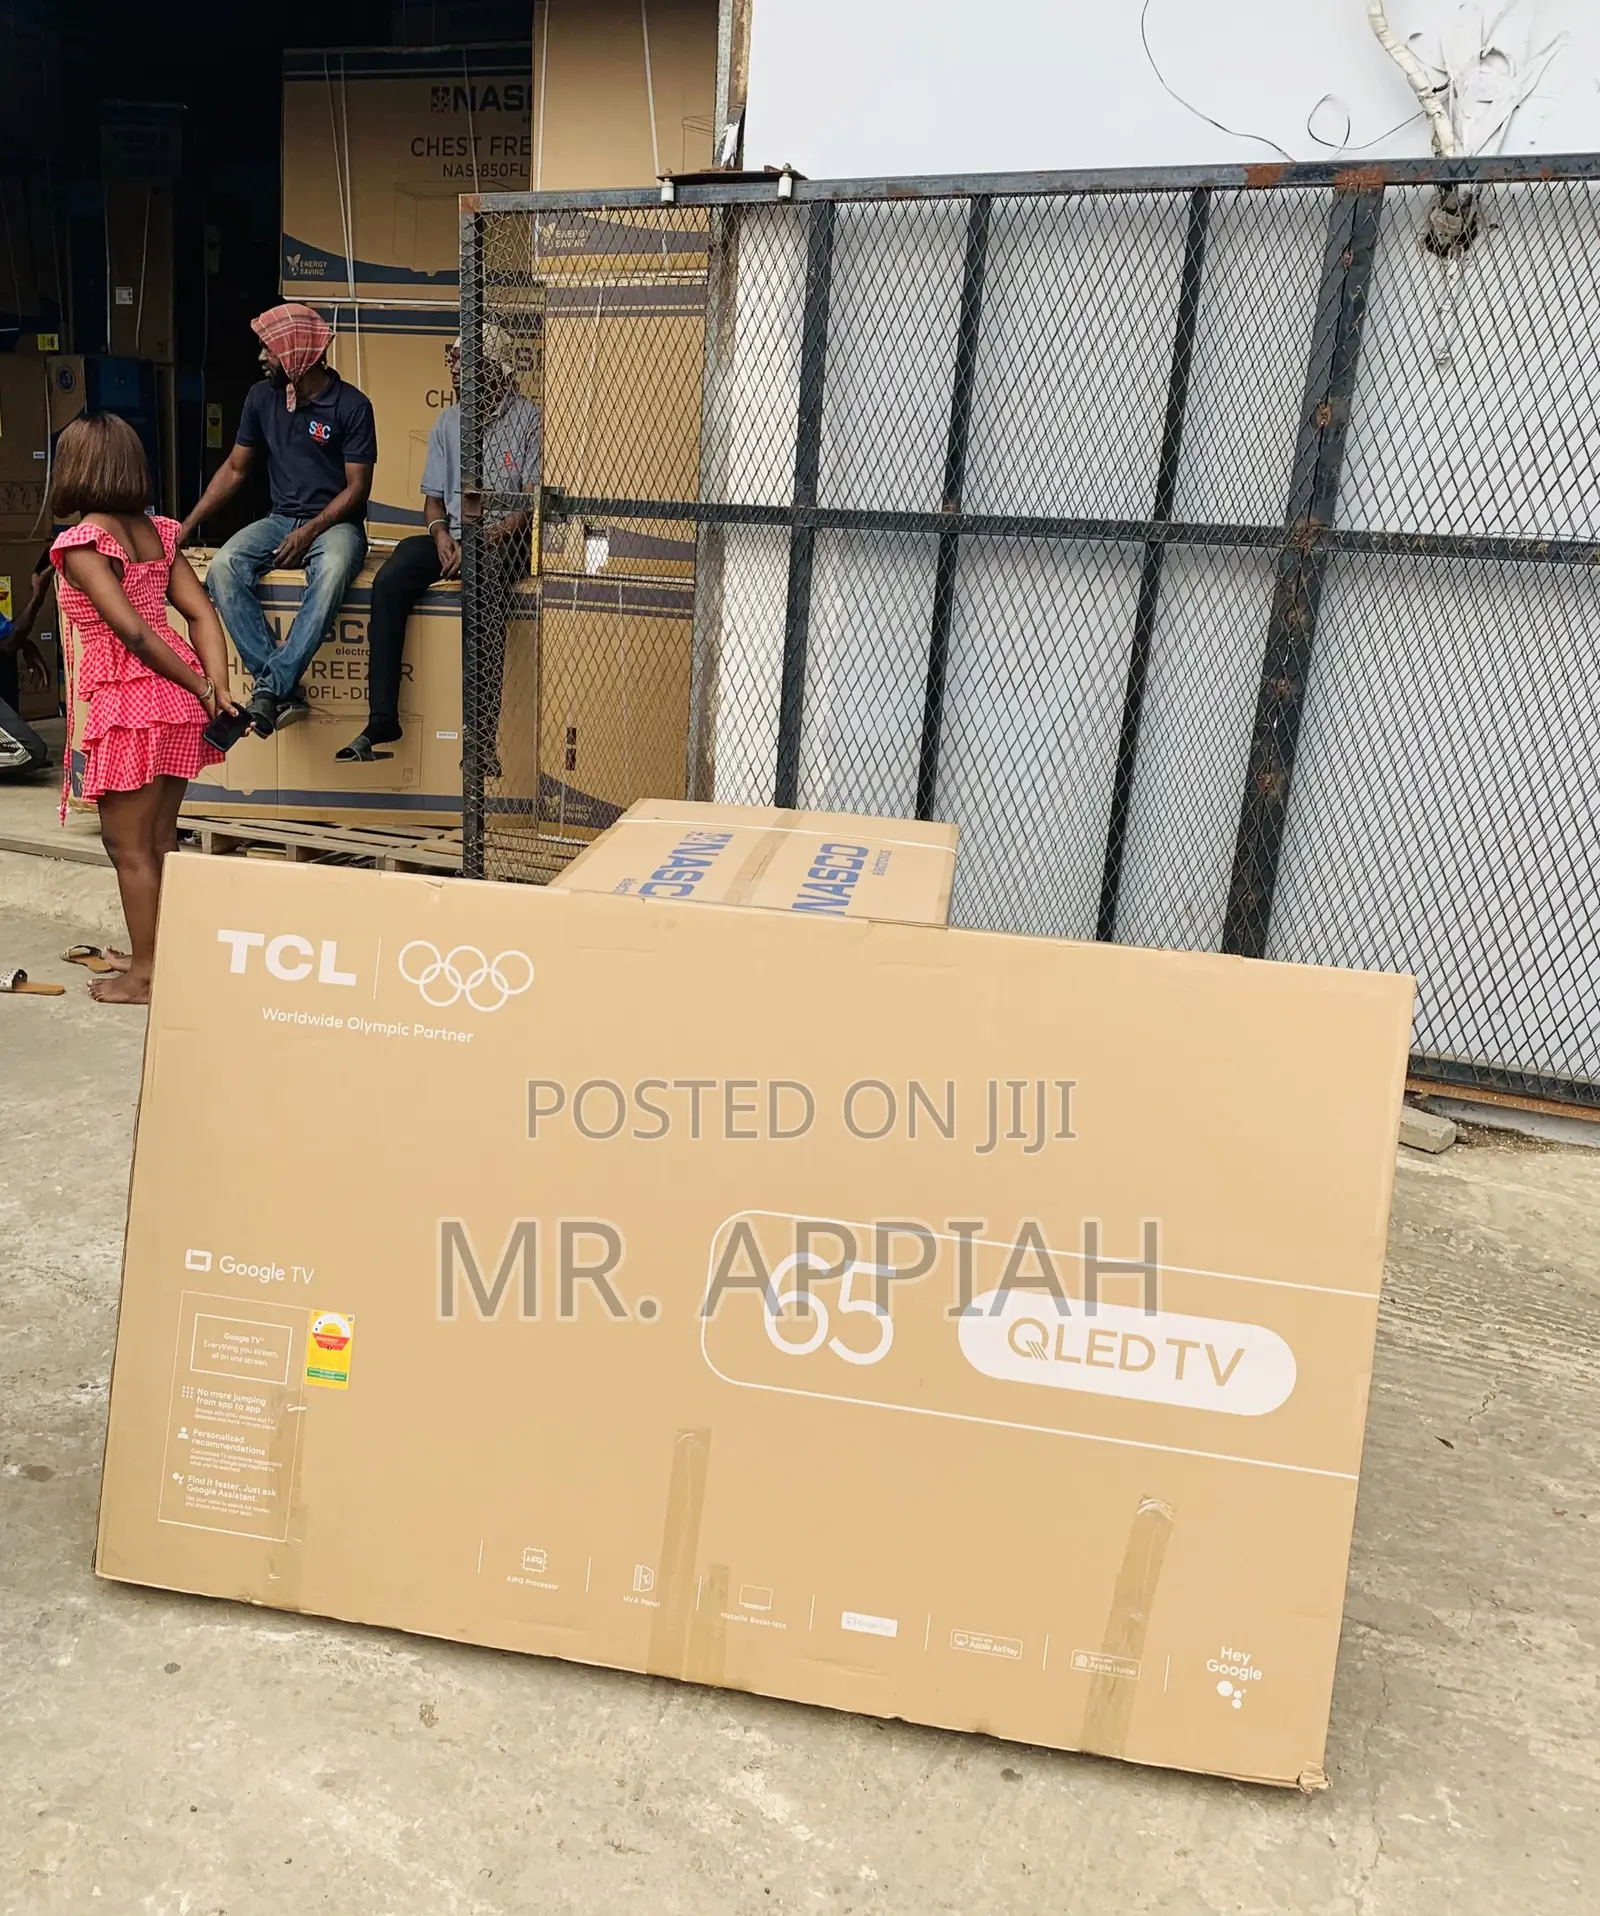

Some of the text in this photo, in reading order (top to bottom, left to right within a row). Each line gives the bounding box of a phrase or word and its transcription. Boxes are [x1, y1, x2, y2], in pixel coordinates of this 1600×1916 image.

[453, 84, 533, 113] NAS
[410, 136, 482, 157] CHEST
[300, 260, 327, 268] ENERGY
[300, 268, 325, 276] SAVING
[309, 420, 331, 440] S&C
[638, 841, 727, 897] NASC
[791, 843, 869, 917] NASCO
[217, 928, 357, 987] TCL
[261, 1006, 474, 1043] Worldwide Olympic Partner
[219, 1255, 316, 1285] Google TV
[763, 1251, 896, 1366] 65
[203, 1339, 239, 1354] Everything
[239, 1346, 253, 1355] you
[1007, 1316, 1246, 1388] QLED TV
[196, 1397, 261, 1414] from app to app
[197, 1387, 267, 1408] No more jumping
[192, 1427, 245, 1444] Personalized
[191, 1438, 267, 1456] recommendations
[186, 1483, 217, 1496] Google
[217, 1490, 259, 1504] Assistant.
[187, 1474, 206, 1485] Find
[214, 1479, 242, 1492] faster.
[243, 1484, 261, 1495] Just
[262, 1487, 277, 1497] ask
[525, 1578, 560, 1591] Processor
[622, 1595, 640, 1605] HVA
[720, 1611, 749, 1623] Metallic
[968, 1640, 1019, 1658] Apple AirPlay
[1220, 1645, 1252, 1667] Hey
[1088, 1660, 1112, 1672] Apple
[1206, 1658, 1263, 1682] Google
